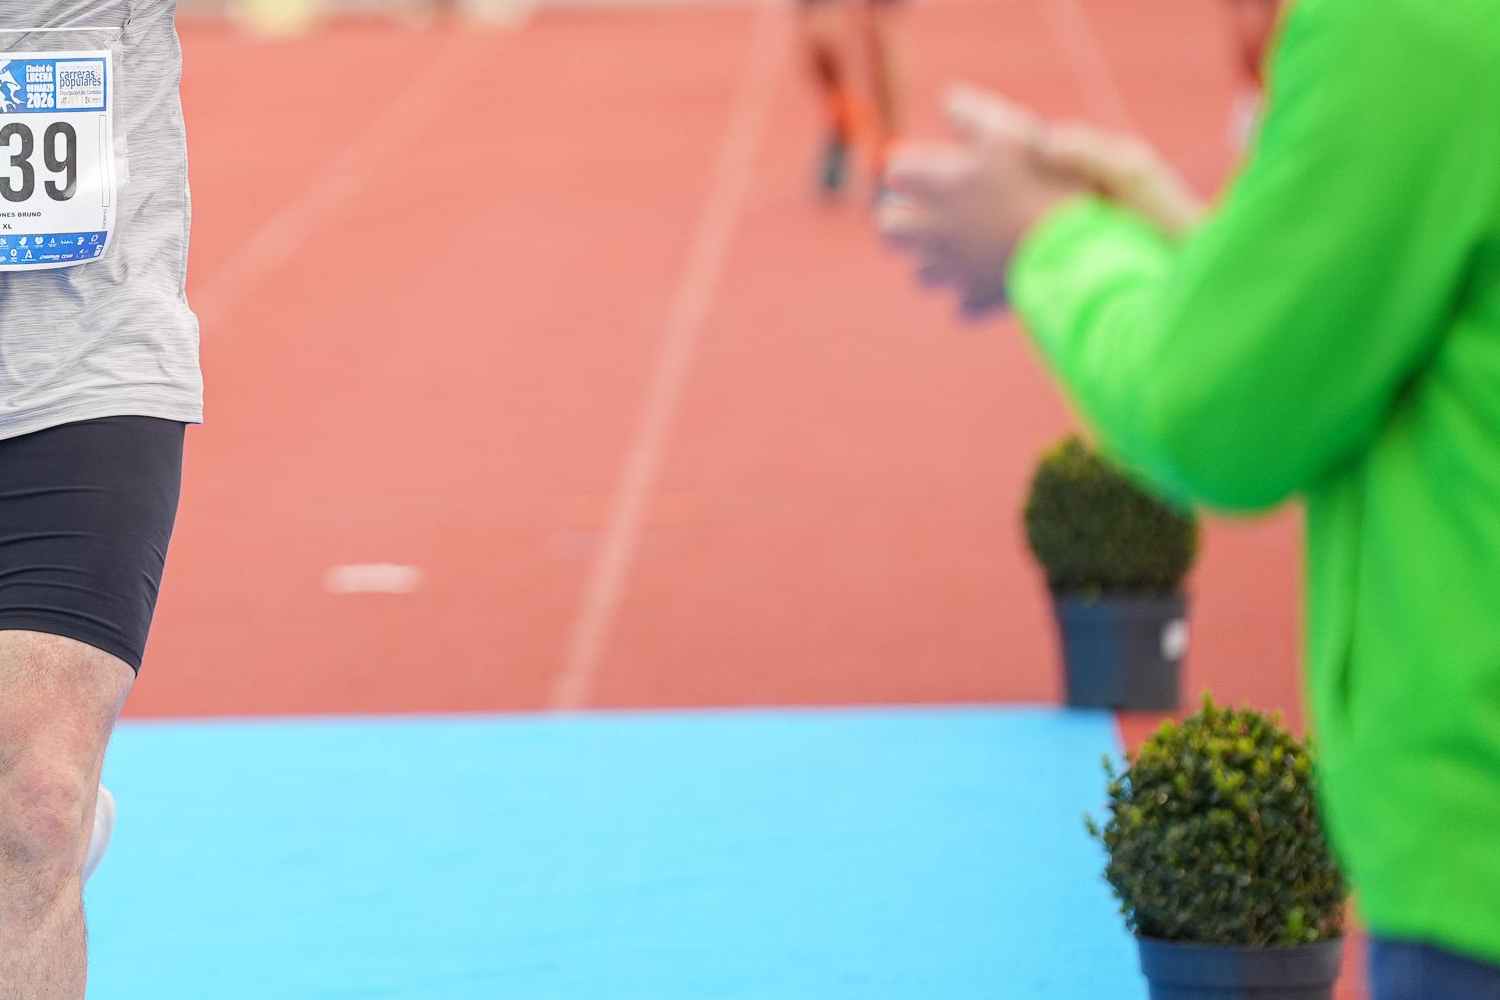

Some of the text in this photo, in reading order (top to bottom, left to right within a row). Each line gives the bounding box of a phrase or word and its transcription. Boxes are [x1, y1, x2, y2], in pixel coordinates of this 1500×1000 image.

[26, 72, 53, 83] LUCENA
[60, 70, 95, 79] carreras
[60, 77, 102, 89] populares
[26, 91, 55, 109] 2026
